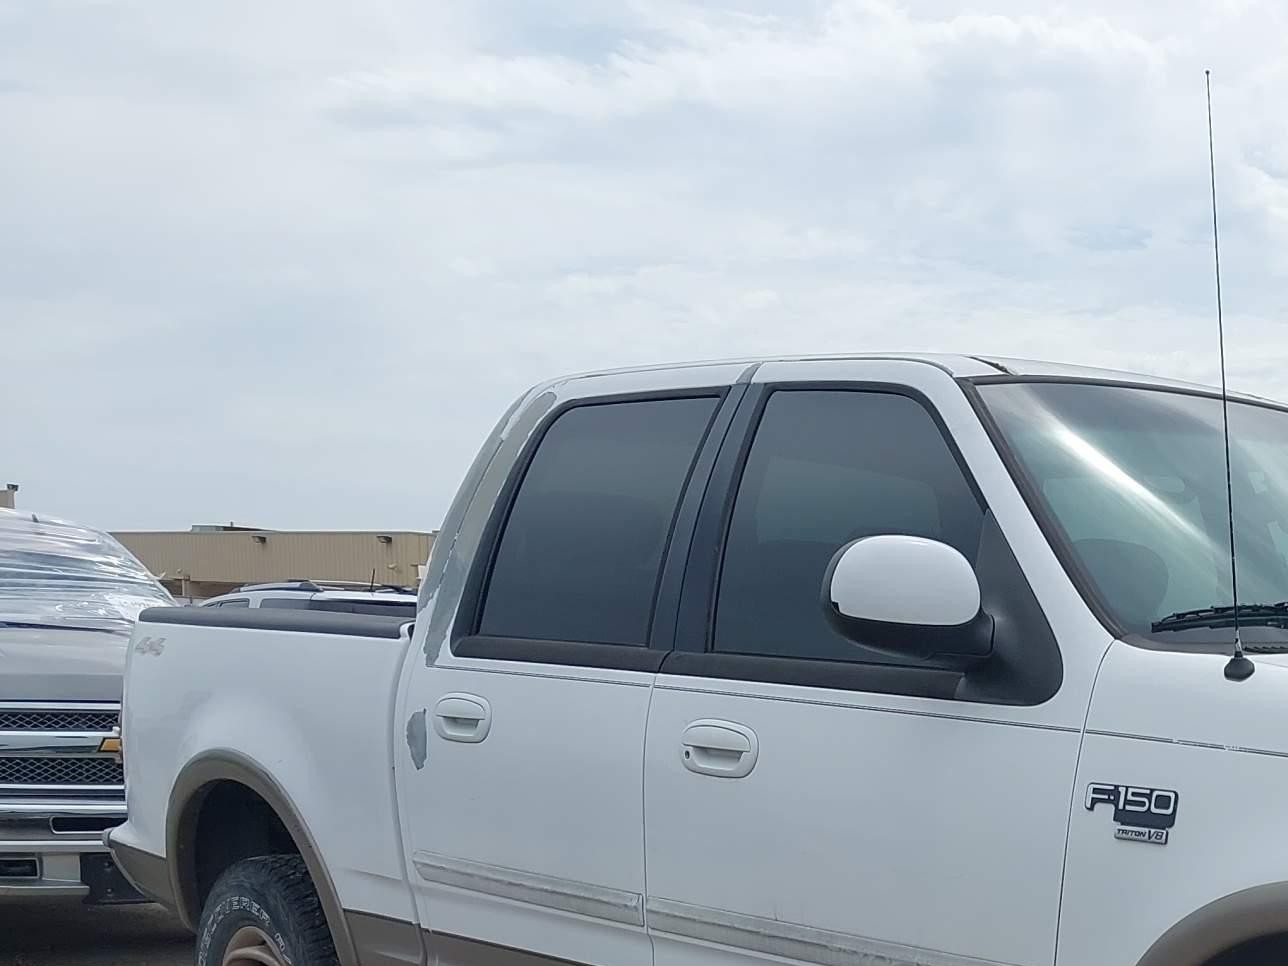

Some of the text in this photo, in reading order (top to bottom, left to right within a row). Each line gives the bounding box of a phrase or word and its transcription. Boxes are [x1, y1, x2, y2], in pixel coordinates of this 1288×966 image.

[1085, 783, 1177, 815] F-150
[1117, 828, 1165, 841] TRITON V8
